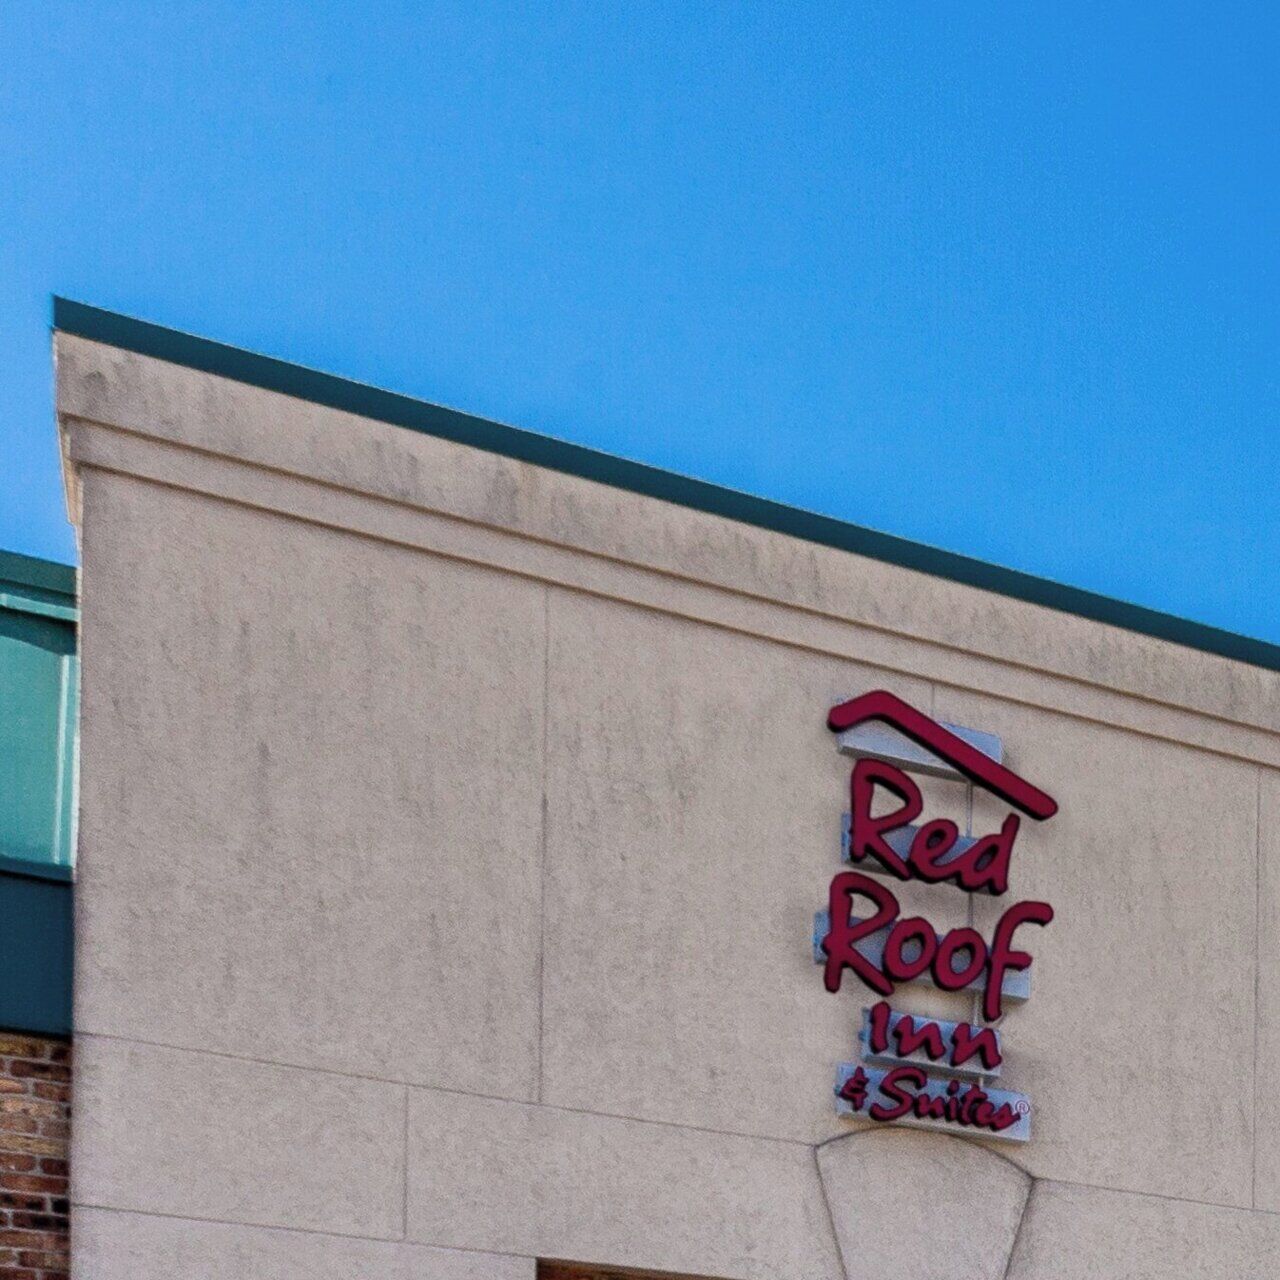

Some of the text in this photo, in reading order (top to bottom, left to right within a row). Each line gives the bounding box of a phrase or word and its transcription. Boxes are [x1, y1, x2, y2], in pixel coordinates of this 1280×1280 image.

[850, 758, 1020, 896] Red
[823, 871, 1054, 1022] Roof
[869, 1001, 1002, 1070] Inn
[839, 1066, 870, 1112] &
